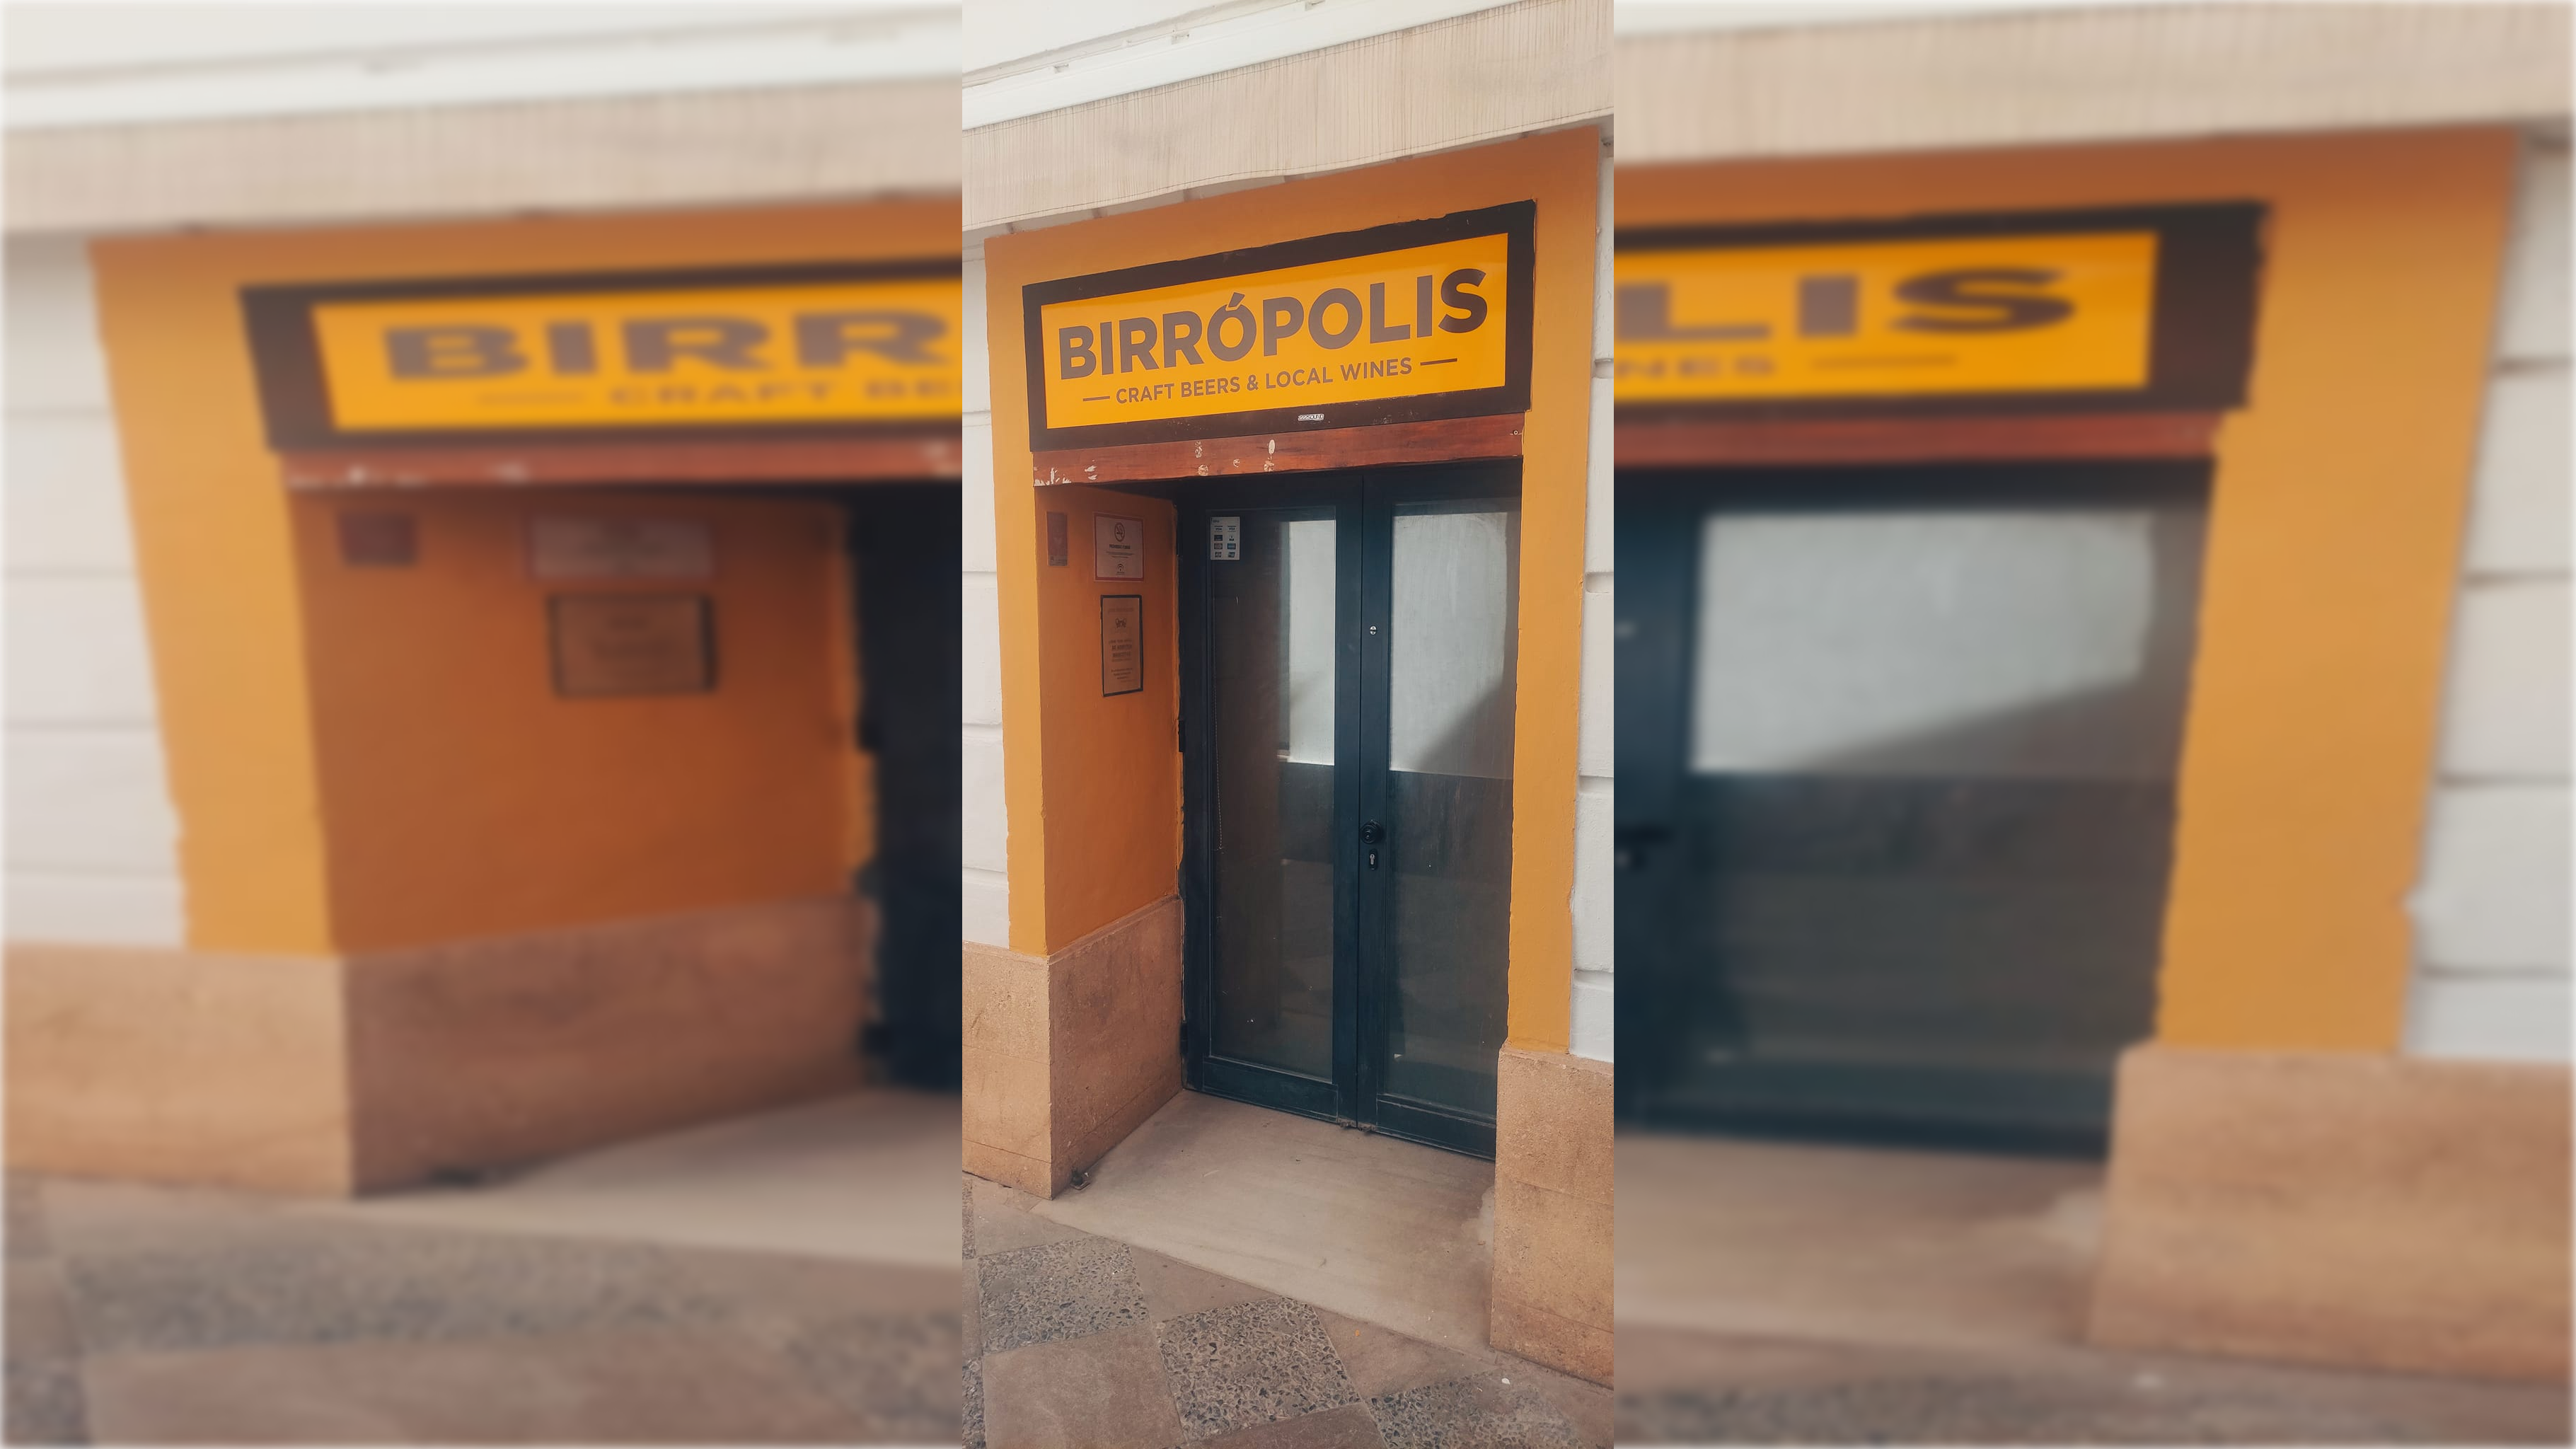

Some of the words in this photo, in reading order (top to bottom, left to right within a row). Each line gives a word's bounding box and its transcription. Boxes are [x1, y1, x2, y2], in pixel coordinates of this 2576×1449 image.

[1059, 270, 1487, 379] BIRRÓPOLIS
[1116, 383, 1175, 403] CRAFT
[1181, 376, 1240, 398] BEERS
[1247, 374, 1259, 391] &
[1264, 368, 1333, 390] LOCAL
[1341, 357, 1412, 381] WINES
